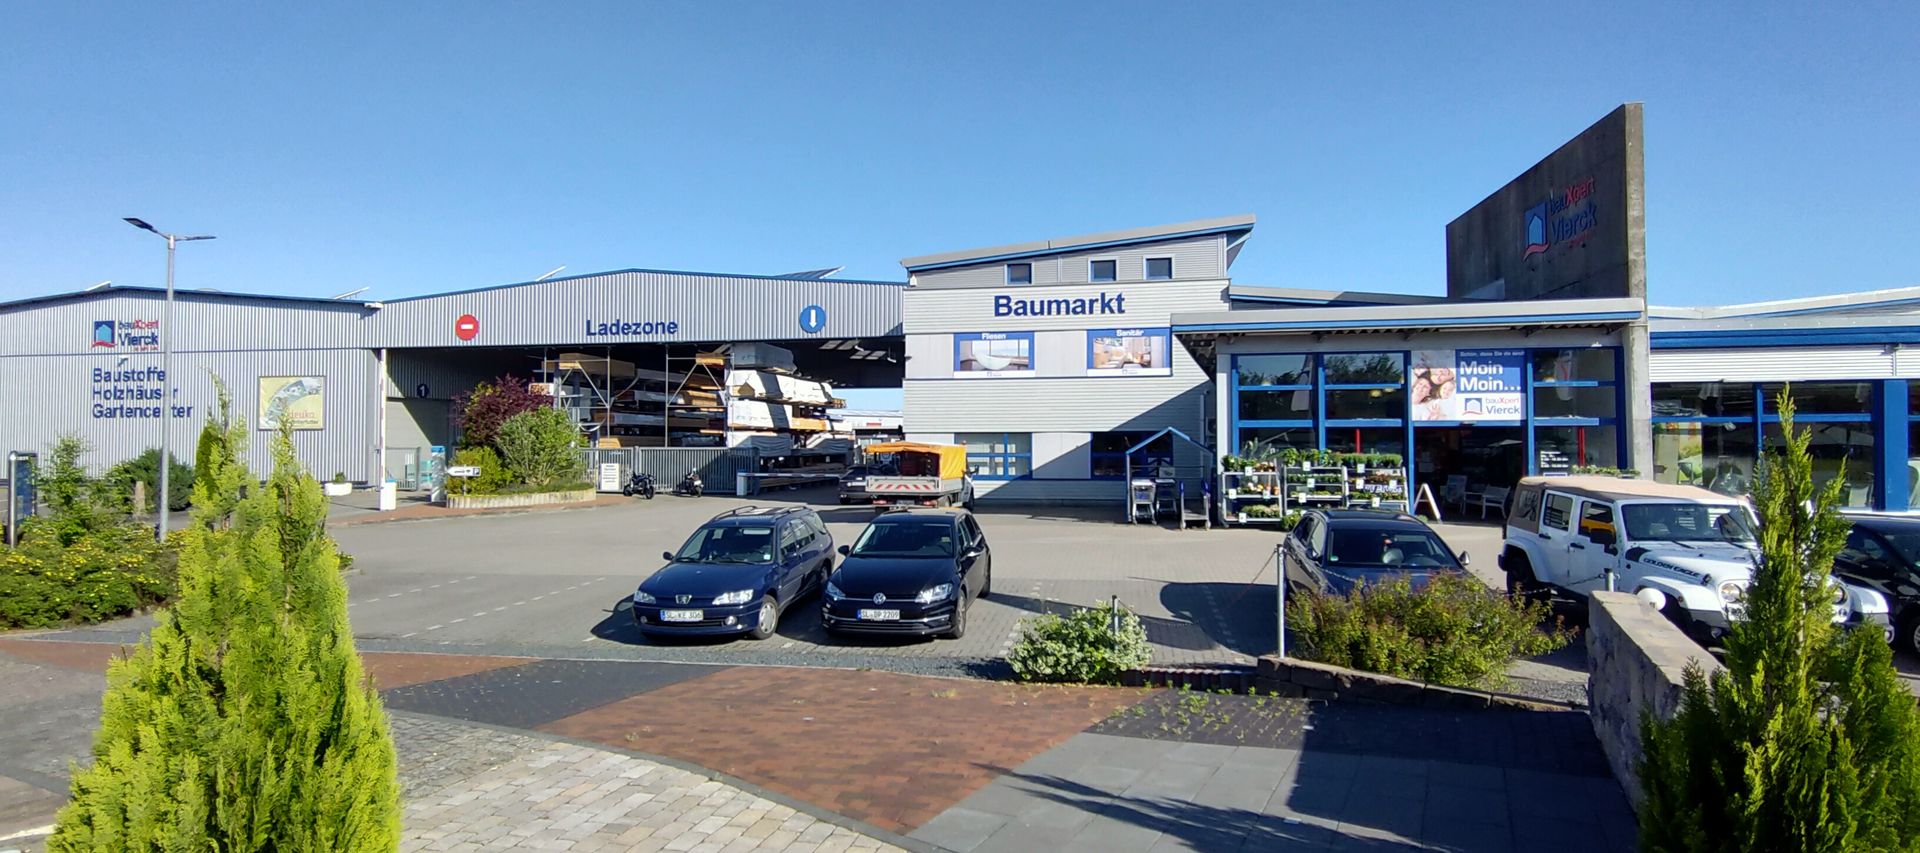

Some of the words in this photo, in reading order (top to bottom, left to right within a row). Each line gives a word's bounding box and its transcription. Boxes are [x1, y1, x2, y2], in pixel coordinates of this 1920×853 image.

[1551, 201, 1597, 245] Vierck
[993, 292, 1126, 318] Baumarkt
[586, 319, 678, 336] Ladezone
[118, 332, 159, 346] Vierck
[93, 367, 165, 382] Baustoffe
[1460, 361, 1503, 375] Moin
[1460, 376, 1521, 391] Moin...
[93, 385, 178, 400] Holzhäusr
[92, 403, 193, 418] Gartenceter
[1486, 405, 1520, 414] Vierck
